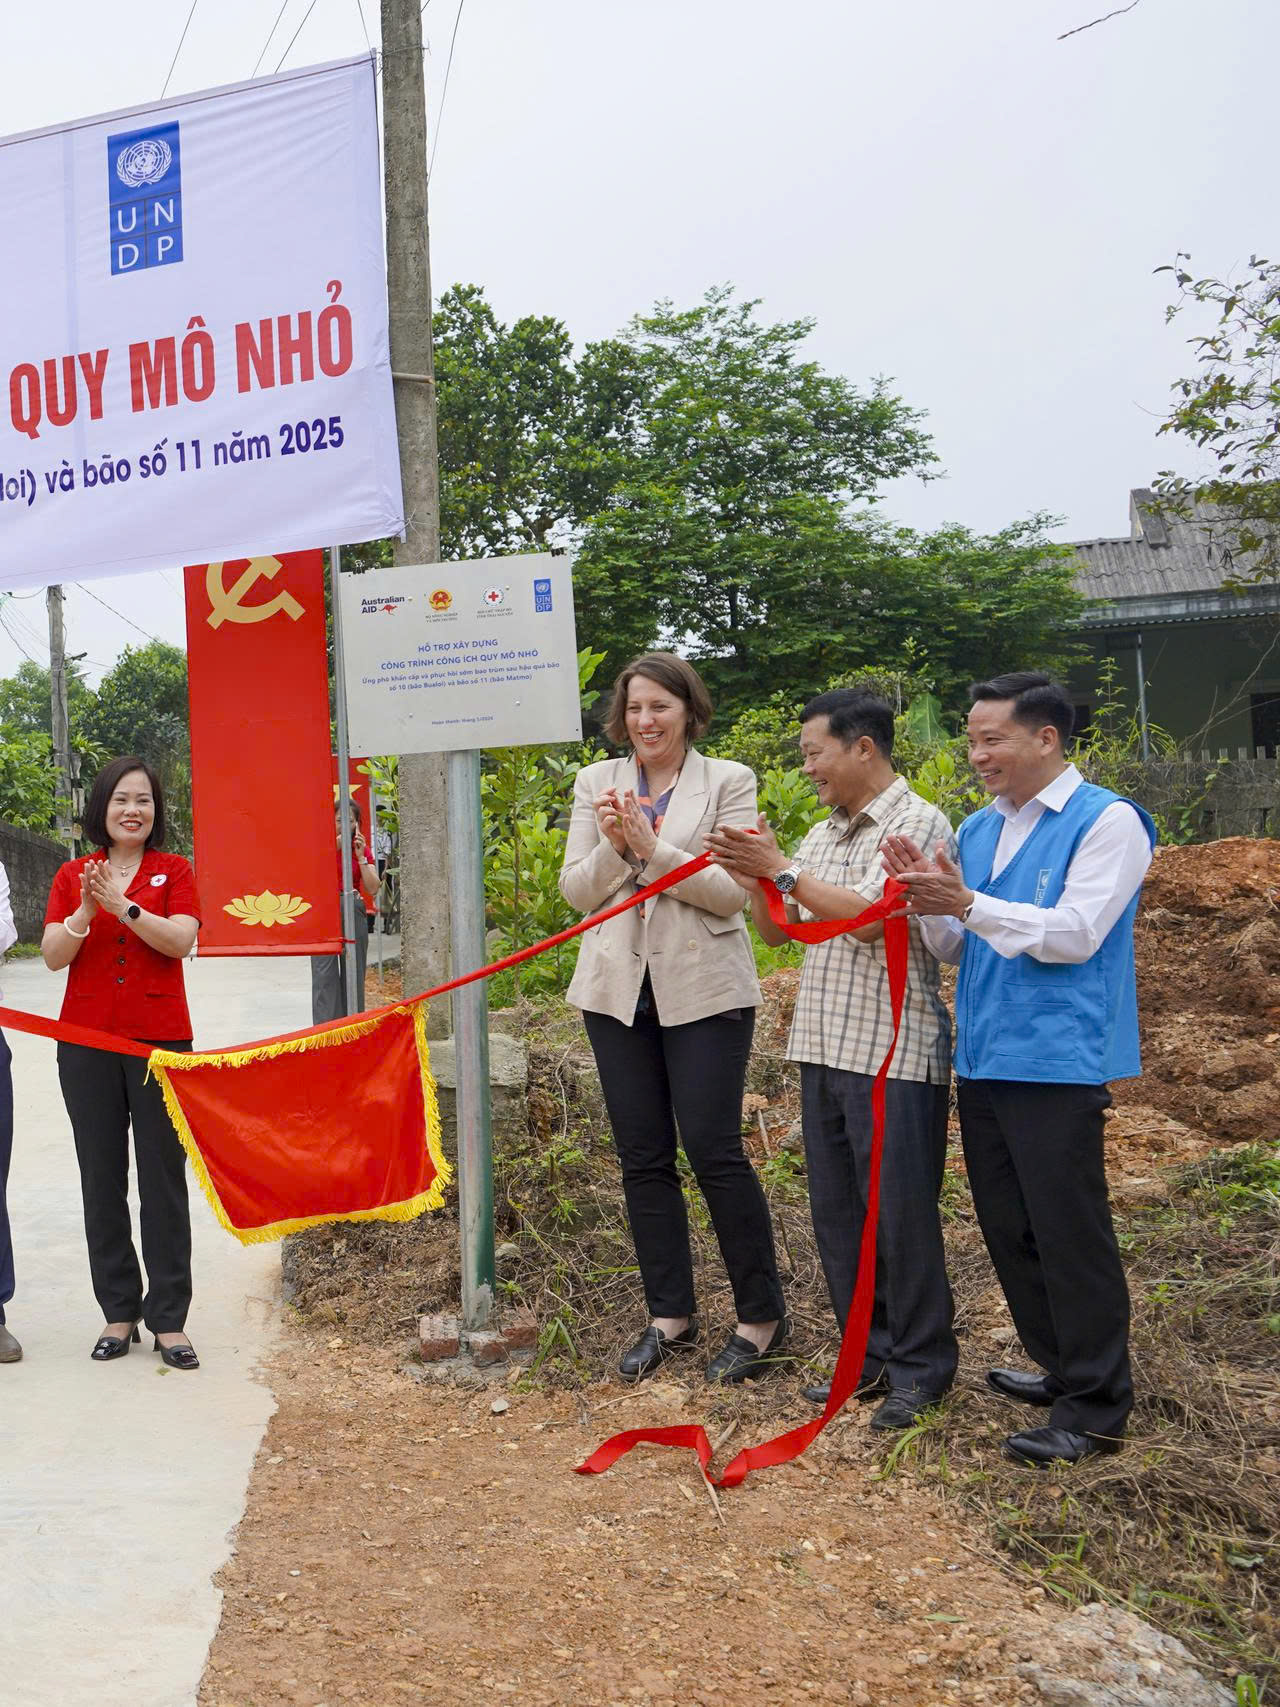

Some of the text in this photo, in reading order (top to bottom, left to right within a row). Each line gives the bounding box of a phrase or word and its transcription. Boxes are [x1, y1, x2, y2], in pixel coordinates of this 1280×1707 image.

[9, 348, 109, 441] QUY
[129, 315, 216, 413] MÔ
[235, 279, 353, 394] NHỎ
[45, 459, 75, 494] và
[83, 454, 131, 488] bão
[139, 437, 168, 479] số
[176, 440, 202, 472] 11
[214, 430, 271, 467] năm
[279, 416, 345, 456] 2025
[361, 595, 405, 606] Australian
[362, 606, 377, 614] AID
[453, 640, 469, 650] XÂY
[381, 660, 406, 671] CÔNG
[408, 658, 434, 668] TRÌNH
[436, 655, 460, 666] CÔNG
[480, 653, 498, 663] QUY
